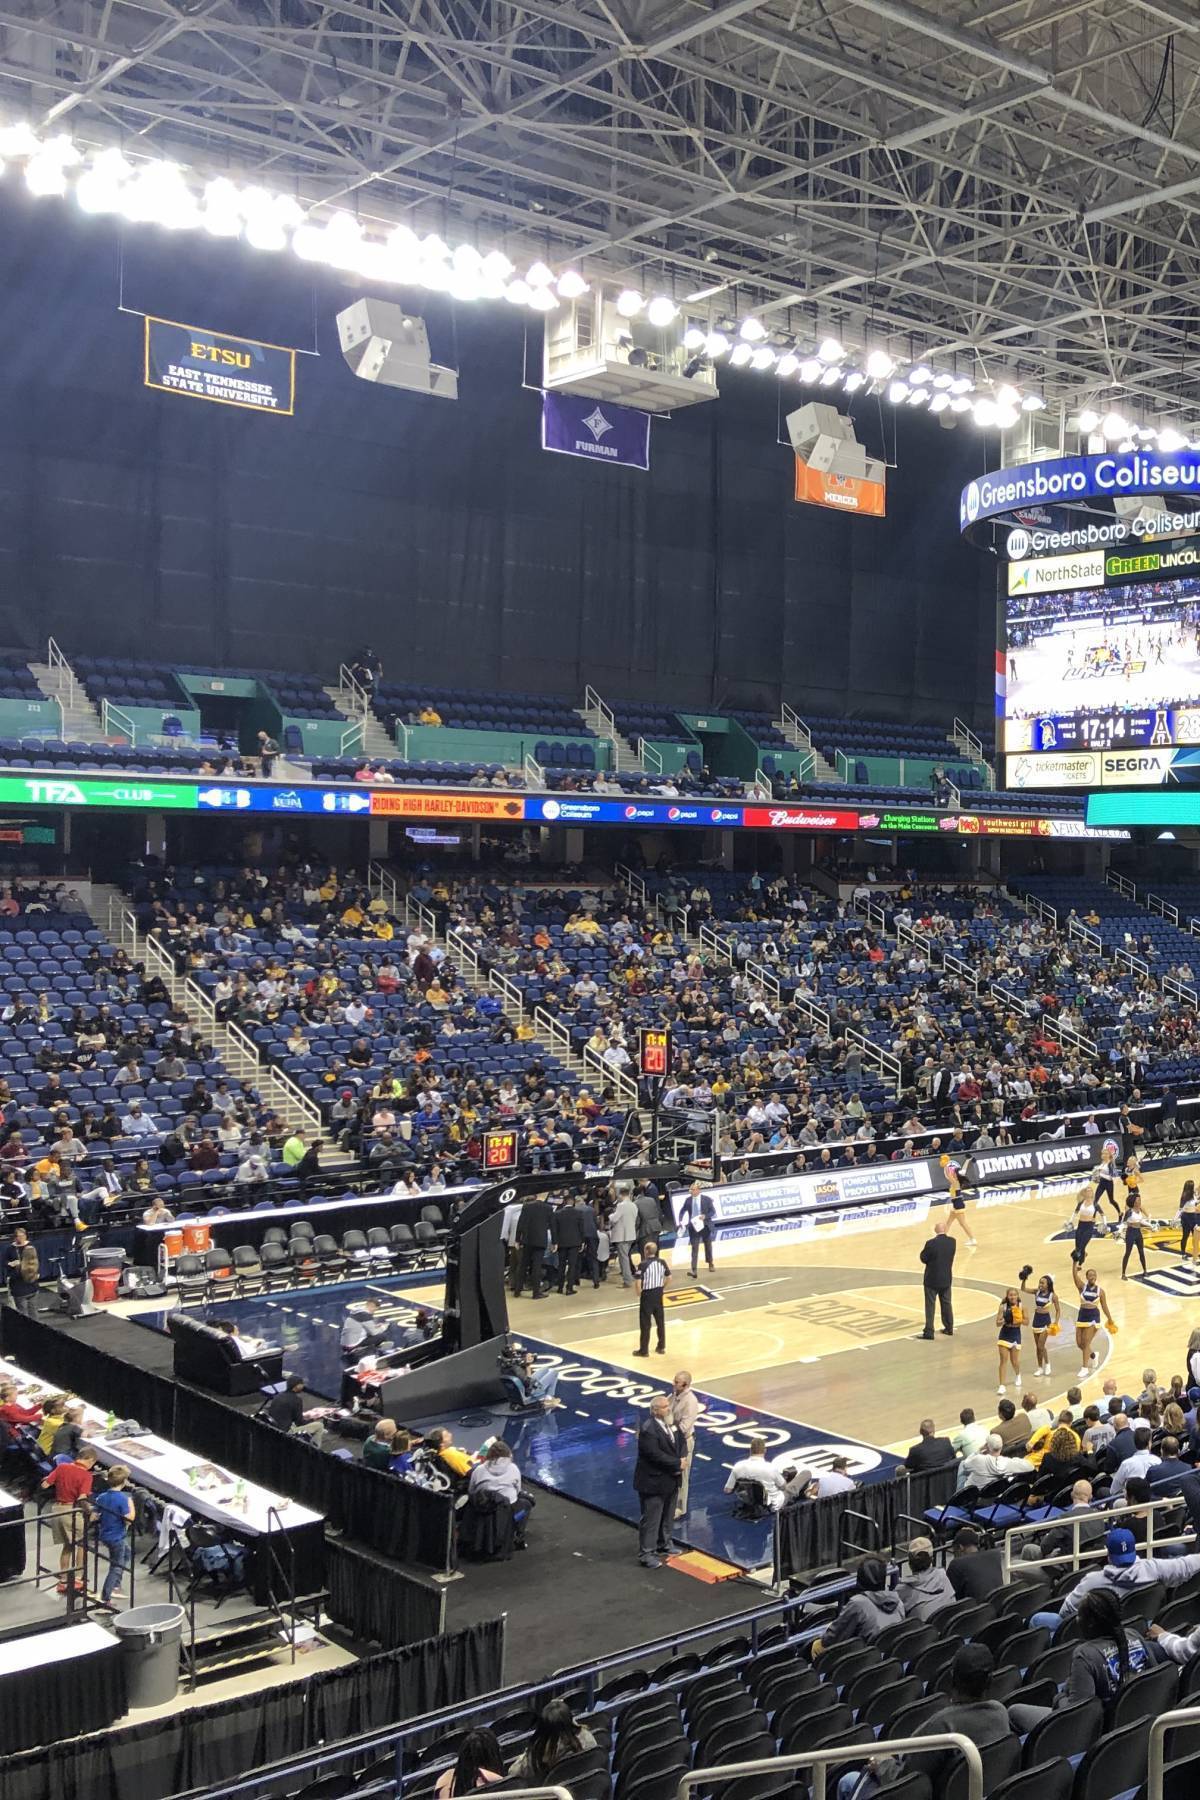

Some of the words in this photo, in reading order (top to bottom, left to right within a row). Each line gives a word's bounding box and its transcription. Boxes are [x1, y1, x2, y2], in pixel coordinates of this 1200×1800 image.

[191, 342, 250, 368] ETSU
[168, 364, 202, 381] EAST
[204, 372, 272, 396] TENNESSEE
[162, 375, 203, 393] STATE
[206, 386, 278, 407] UNIVERSITY
[575, 440, 618, 457] FURMAN
[981, 468, 1086, 509] Greensboro
[824, 491, 859, 507] MERCER
[1031, 522, 1126, 551] Greensboro
[1035, 562, 1103, 583] NorthState
[1106, 554, 1159, 576] GREEN
[1081, 717, 1125, 739] 17:14
[1177, 715, 1200, 739] 28
[1036, 759, 1088, 771] ticketmaster
[1104, 758, 1161, 772] SEGRA
[25, 780, 87, 803] TFA
[114, 788, 153, 801] CLUB
[373, 796, 400, 810] RIDING
[403, 797, 422, 811] HIGH
[560, 803, 600, 812] Greensboro
[560, 810, 592, 818] Coliseum
[637, 809, 654, 817] pepsi
[680, 811, 697, 819] pepsi
[722, 812, 738, 820] pepsi
[769, 810, 837, 826] Budweiser
[884, 814, 911, 823] Charging
[911, 815, 936, 823] Stations
[983, 819, 1018, 827] southwest
[1021, 820, 1035, 829] grill
[1052, 822, 1081, 836] NEWS
[647, 1048, 664, 1071] 20
[490, 1149, 508, 1163] 20
[977, 1153, 1032, 1179] JIMMY
[1036, 1145, 1091, 1170] JOHN'S
[585, 1168, 615, 1179] SPALDING
[844, 1175, 877, 1188] POWERFUL
[878, 1170, 914, 1182] MARKETING
[720, 1191, 757, 1205] POWERFUL
[760, 1185, 800, 1199] MARKETING
[814, 1184, 839, 1195] JASON
[846, 1185, 878, 1197] PROVEN
[880, 1180, 915, 1193] SYSTEMS
[723, 1203, 760, 1216] PROVEN
[762, 1197, 800, 1210] SYSTEMS
[528, 1354, 791, 1449] Grensboro
